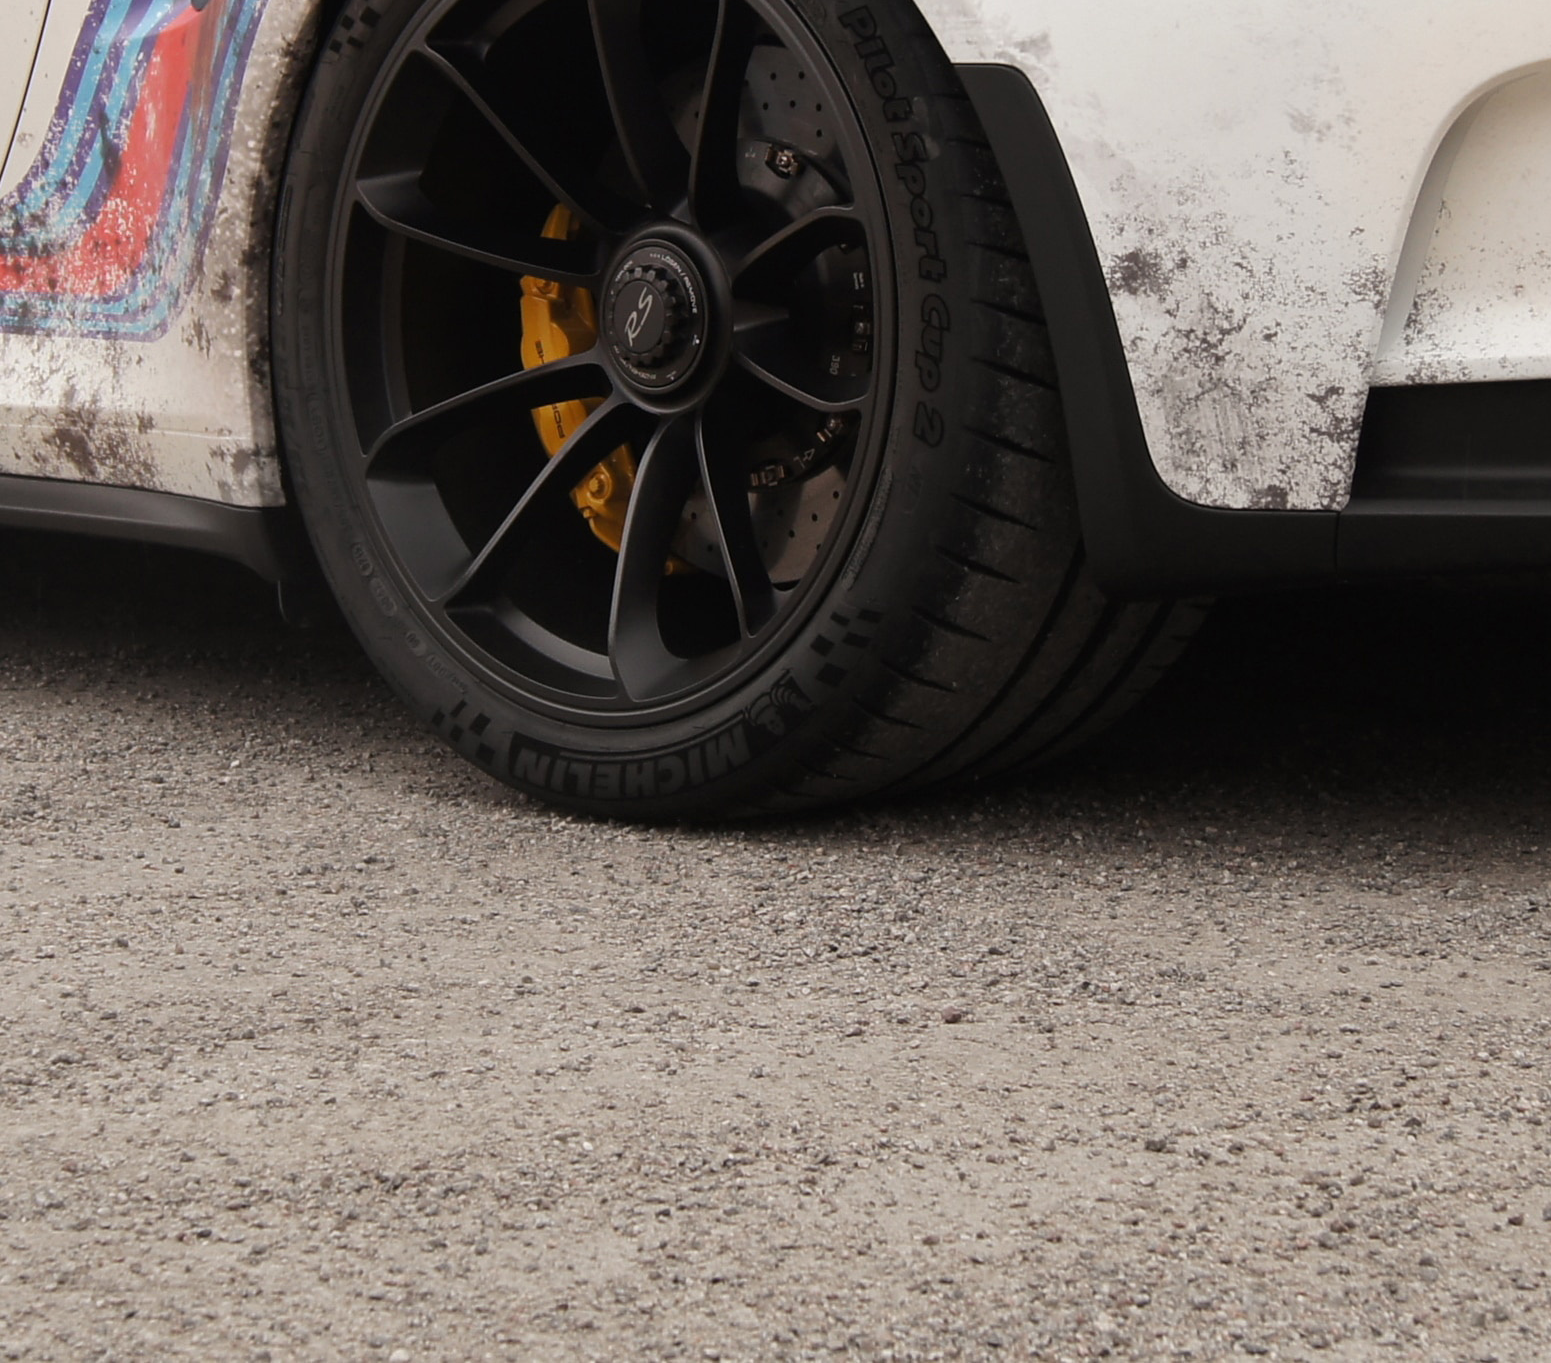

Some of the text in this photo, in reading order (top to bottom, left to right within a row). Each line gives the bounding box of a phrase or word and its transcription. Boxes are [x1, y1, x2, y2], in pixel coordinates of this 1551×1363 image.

[838, 5, 950, 448] Pilot Sport Cup 2
[624, 286, 654, 348] RS
[512, 723, 749, 795] MICHELIN
